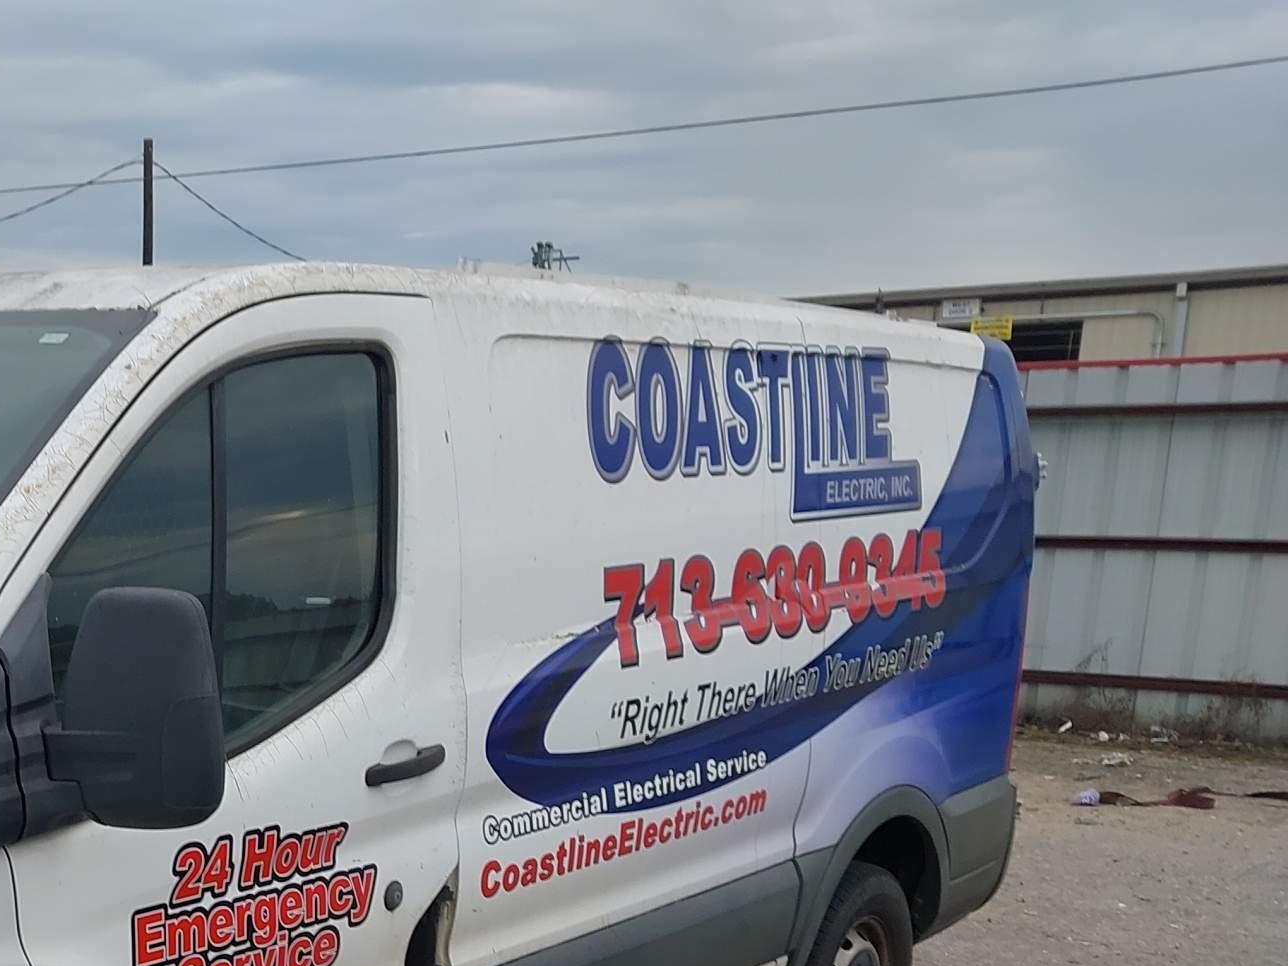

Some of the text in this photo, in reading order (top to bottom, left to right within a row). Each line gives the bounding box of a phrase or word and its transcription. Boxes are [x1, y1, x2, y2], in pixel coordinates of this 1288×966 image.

[586, 335, 894, 522] COASTLINE
[826, 475, 913, 504] ELECTRIC, INC.
[603, 528, 947, 669] 713-630-9345
[696, 680, 758, 719] There
[762, 666, 818, 708] When
[823, 652, 860, 693] You
[861, 643, 907, 686] Need
[480, 788, 768, 898] CoastlineElectric.com
[483, 749, 768, 845] Commercial Electrical Service
[170, 822, 349, 908] 24 Hour
